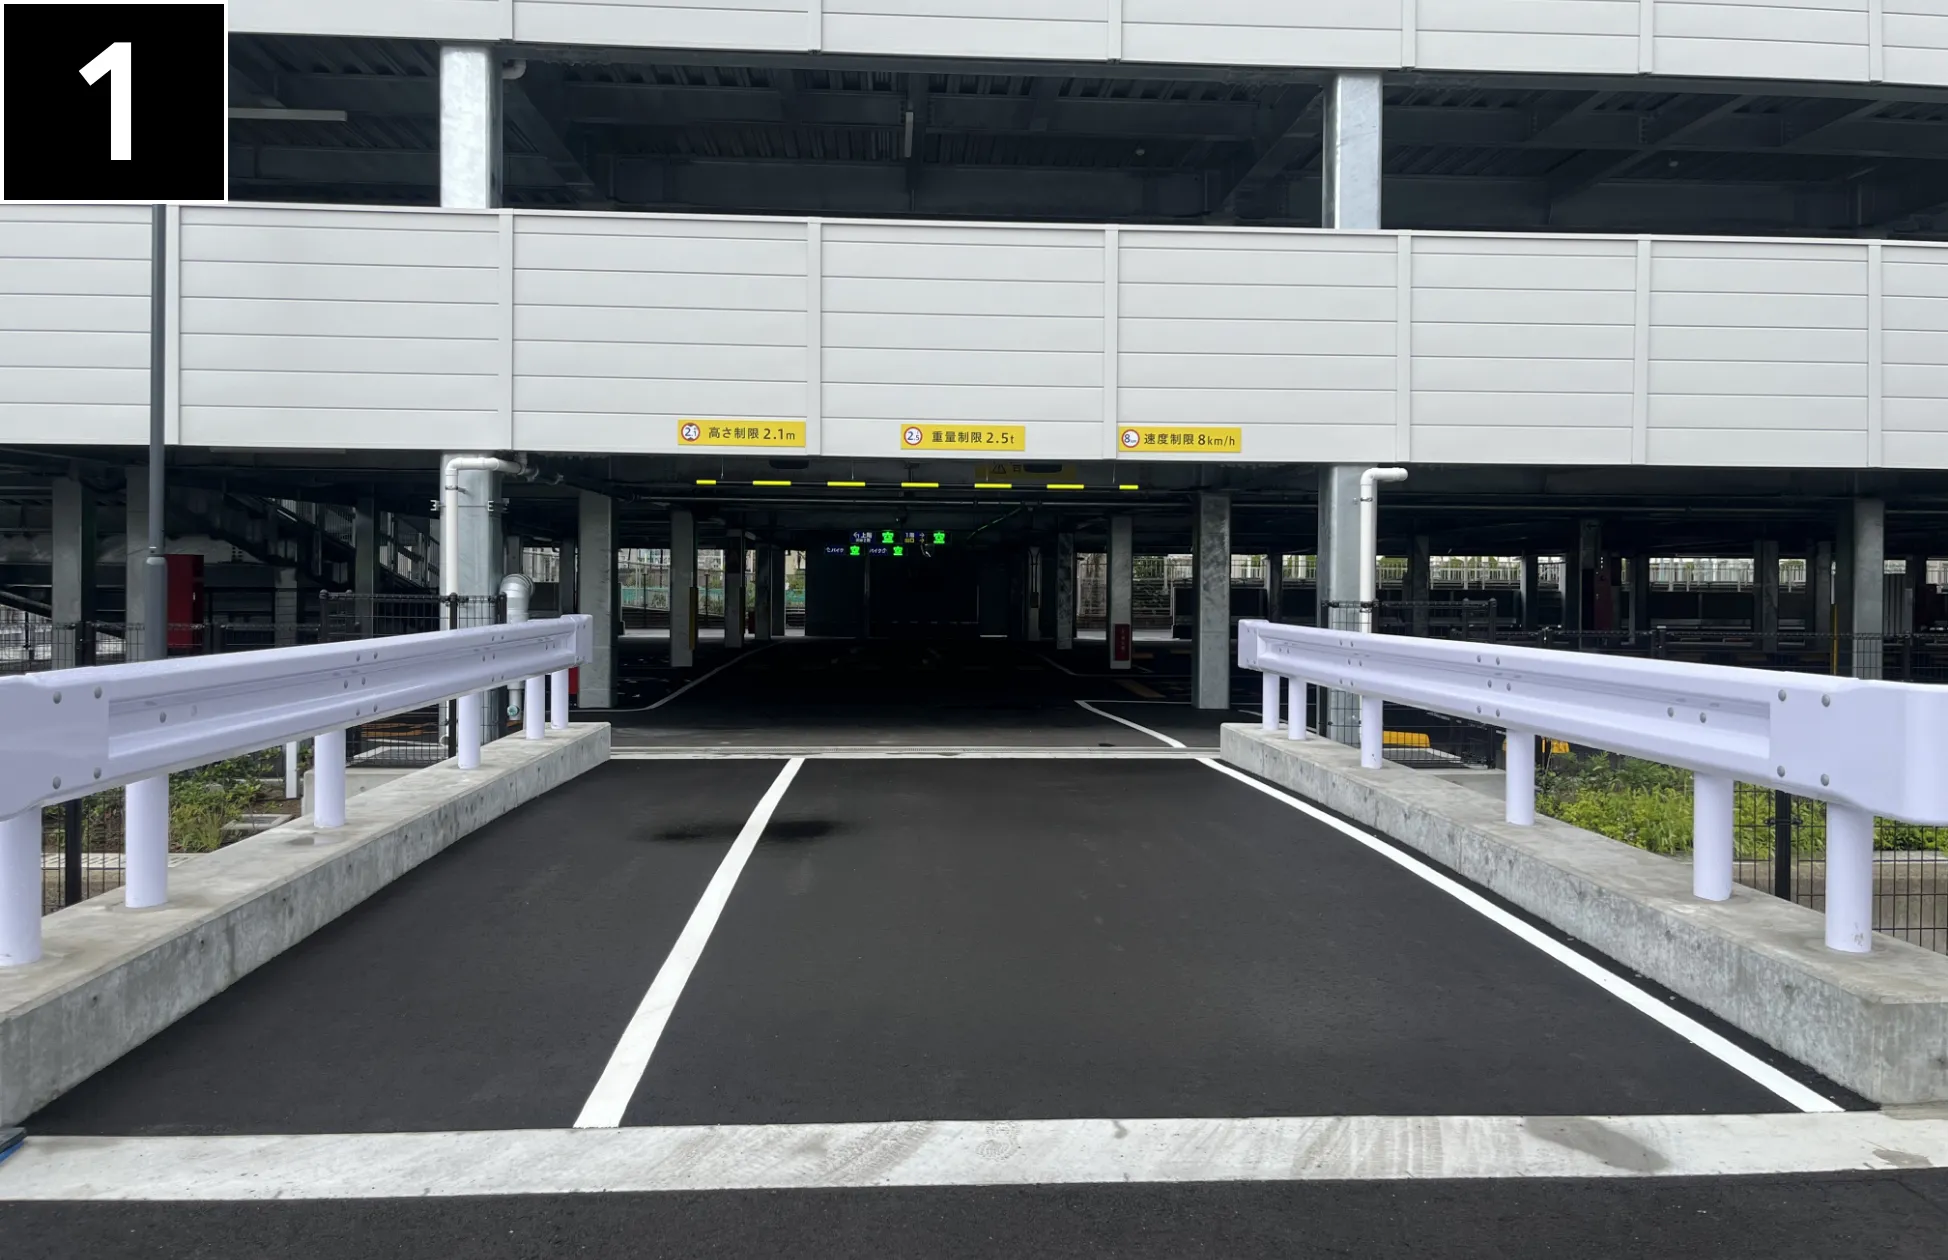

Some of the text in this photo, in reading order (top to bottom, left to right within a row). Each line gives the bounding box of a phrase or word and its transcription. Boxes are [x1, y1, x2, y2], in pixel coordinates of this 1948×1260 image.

[708, 427, 795, 440] 高さ制限 2.1m
[932, 431, 1014, 444] 重量制限 2.5t
[1144, 433, 1235, 446] 速度制限 8km/h
